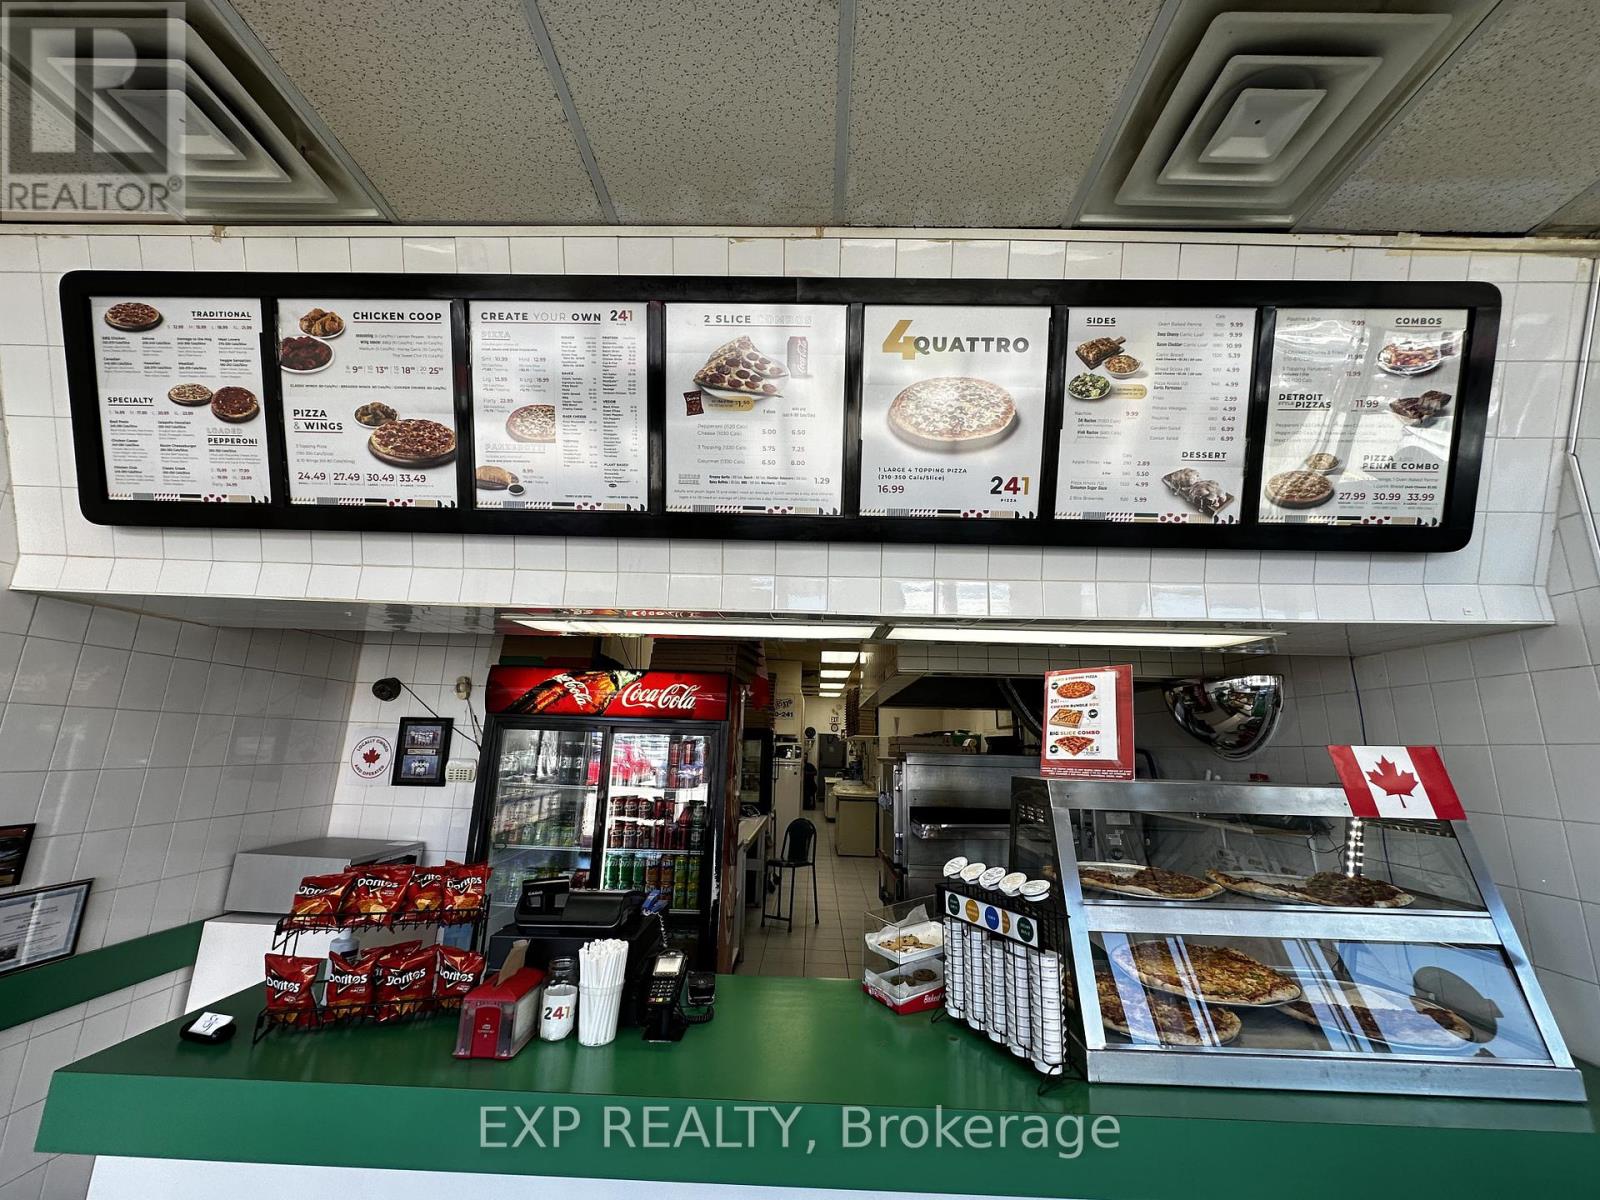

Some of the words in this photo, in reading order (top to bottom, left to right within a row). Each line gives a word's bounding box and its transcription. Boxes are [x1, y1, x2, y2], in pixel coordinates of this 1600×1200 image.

[353, 312, 405, 321] CHICKEN
[409, 312, 442, 321] COOP
[480, 312, 528, 321] CREATE
[532, 312, 566, 321] YOUR
[571, 313, 601, 322] OWN
[609, 309, 633, 322] 241
[703, 314, 711, 323] 2
[715, 314, 751, 323] SLICE
[1395, 317, 1442, 325] COMBOS
[882, 320, 917, 360] 4
[913, 336, 1030, 356] QUATTRO
[108, 396, 154, 404] SPECIALTY
[1278, 393, 1324, 401] DETROIT
[1295, 401, 1332, 409] PIZZAS
[1355, 399, 1379, 408] 11.99
[293, 409, 327, 418] PIZZA
[304, 421, 344, 430] WINGS
[208, 437, 258, 445] PEPPERONI
[1181, 451, 1228, 459] DESSERT
[1363, 454, 1394, 462] PIZZA
[1362, 462, 1398, 470] PENNE
[1401, 463, 1440, 471] COMBO
[298, 471, 326, 481] 24.49
[333, 472, 361, 481] 27.49
[366, 473, 395, 482] 30.49
[399, 473, 426, 483] 33.49
[814, 477, 830, 485] 1.29
[878, 485, 905, 493] 16.99
[990, 475, 1031, 495] 241
[1338, 492, 1366, 501] 27.99
[1372, 492, 1401, 501] 30.99
[1407, 493, 1435, 501] 33.99
[621, 682, 708, 709] Coca-Cola
[357, 878, 400, 890] Doritos
[447, 876, 483, 891] Doritos
[386, 967, 427, 986] Doritos
[266, 975, 301, 993] Doritos
[544, 1006, 571, 1020] 241
